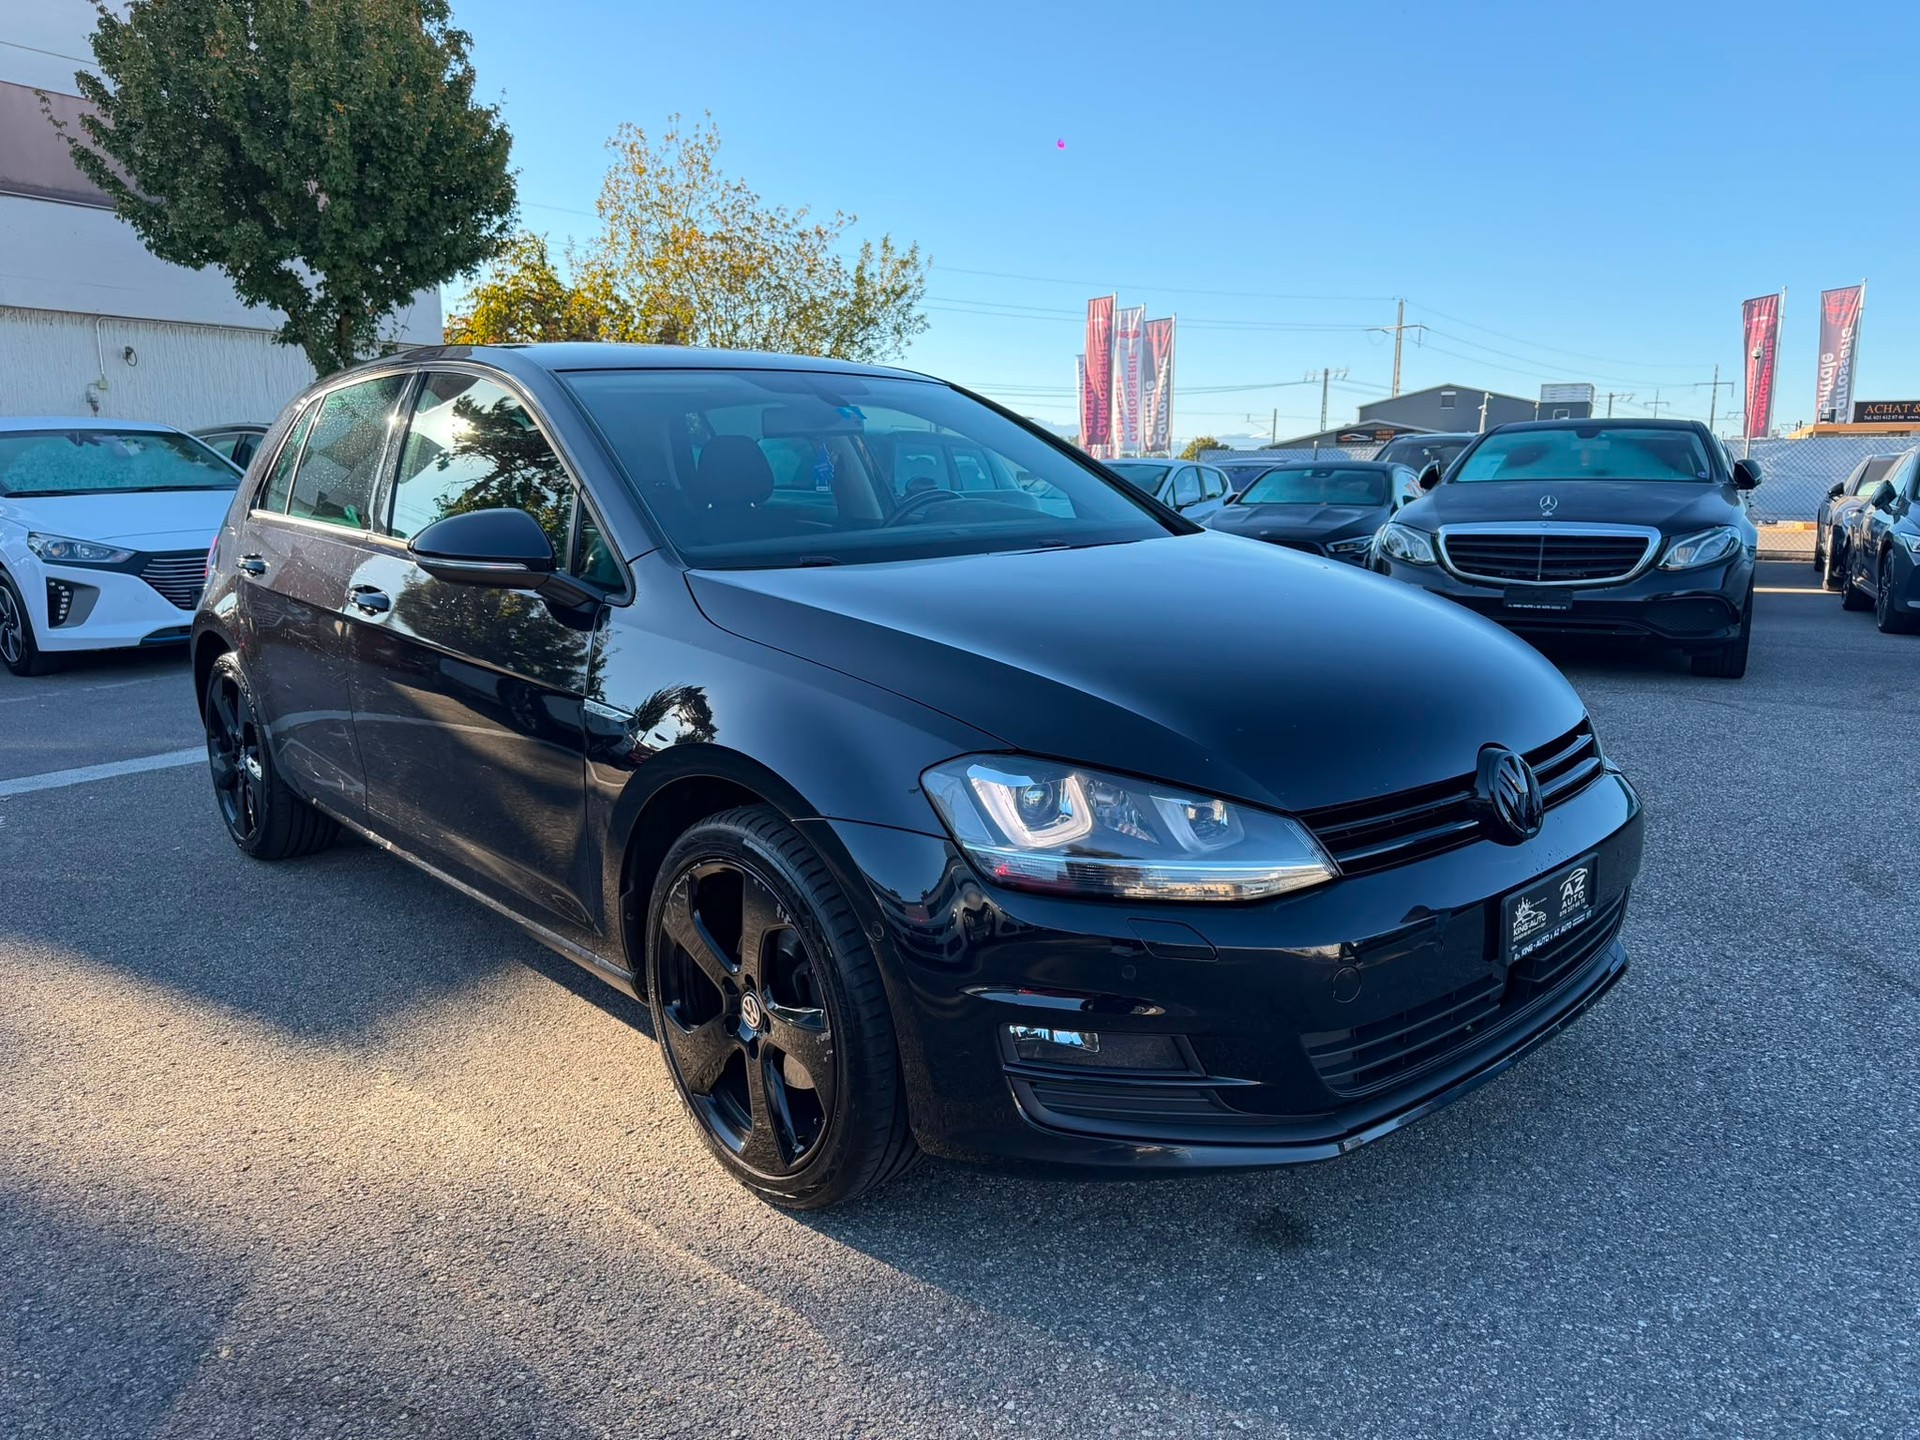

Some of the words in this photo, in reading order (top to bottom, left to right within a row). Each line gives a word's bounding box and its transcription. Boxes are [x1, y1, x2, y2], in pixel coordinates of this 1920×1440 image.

[1864, 403, 1911, 414] ACHAT
[1562, 874, 1586, 901] AZ
[1561, 890, 1584, 909] AUTO
